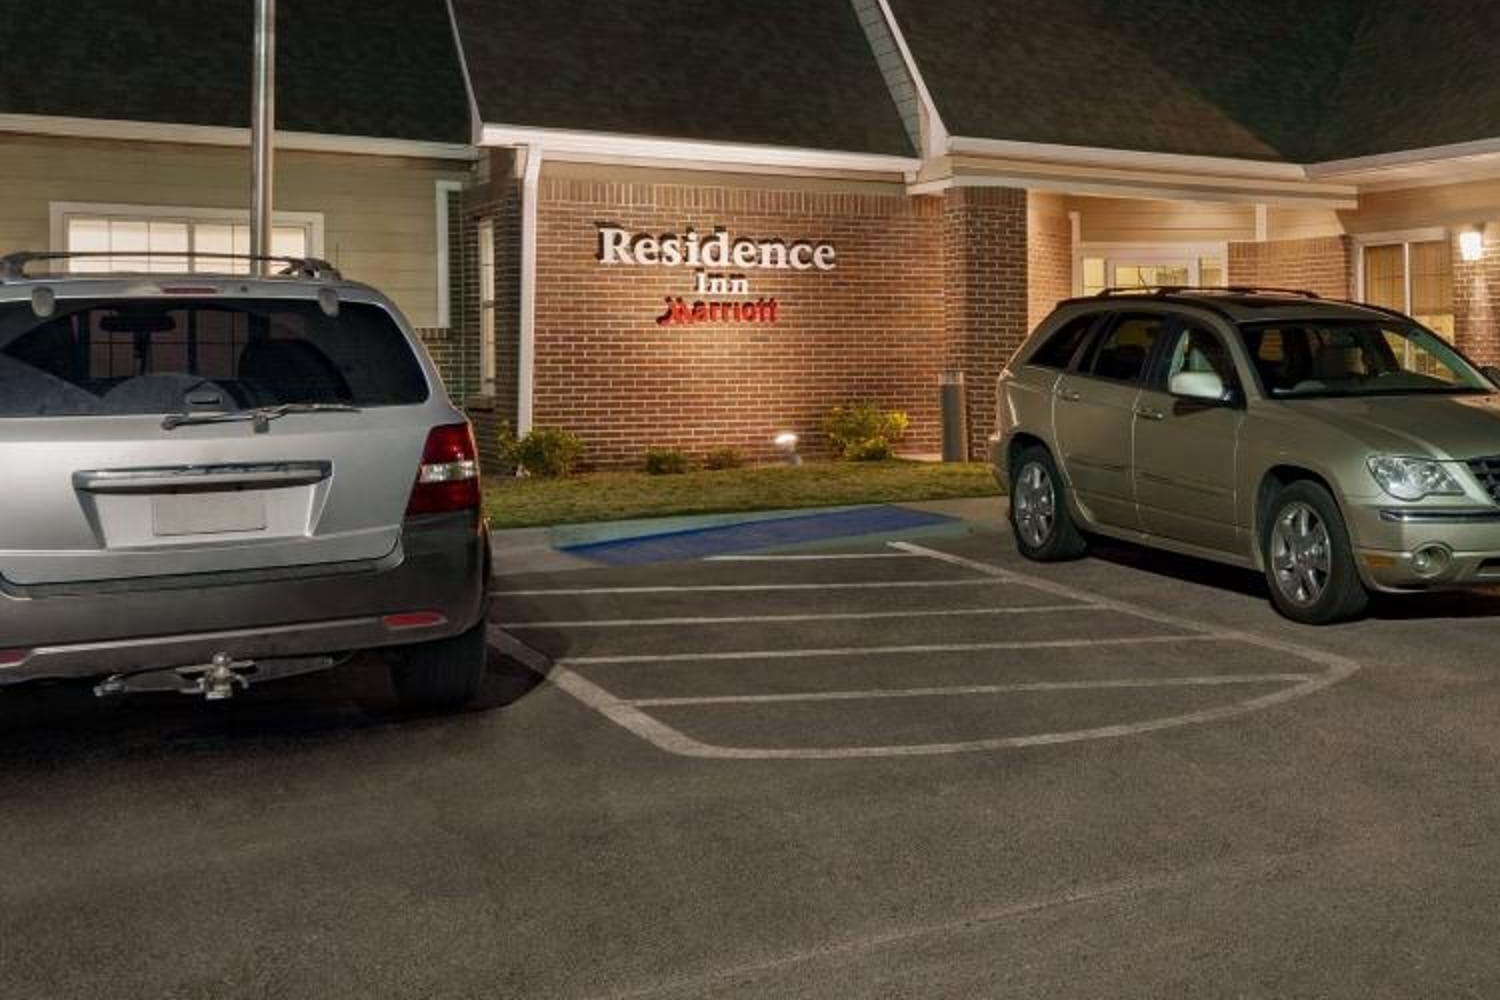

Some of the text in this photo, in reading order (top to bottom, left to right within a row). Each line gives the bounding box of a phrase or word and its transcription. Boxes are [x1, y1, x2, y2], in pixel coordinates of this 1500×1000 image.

[598, 226, 837, 271] Residence
[697, 271, 749, 295] Inn
[658, 299, 778, 327] Marriott
